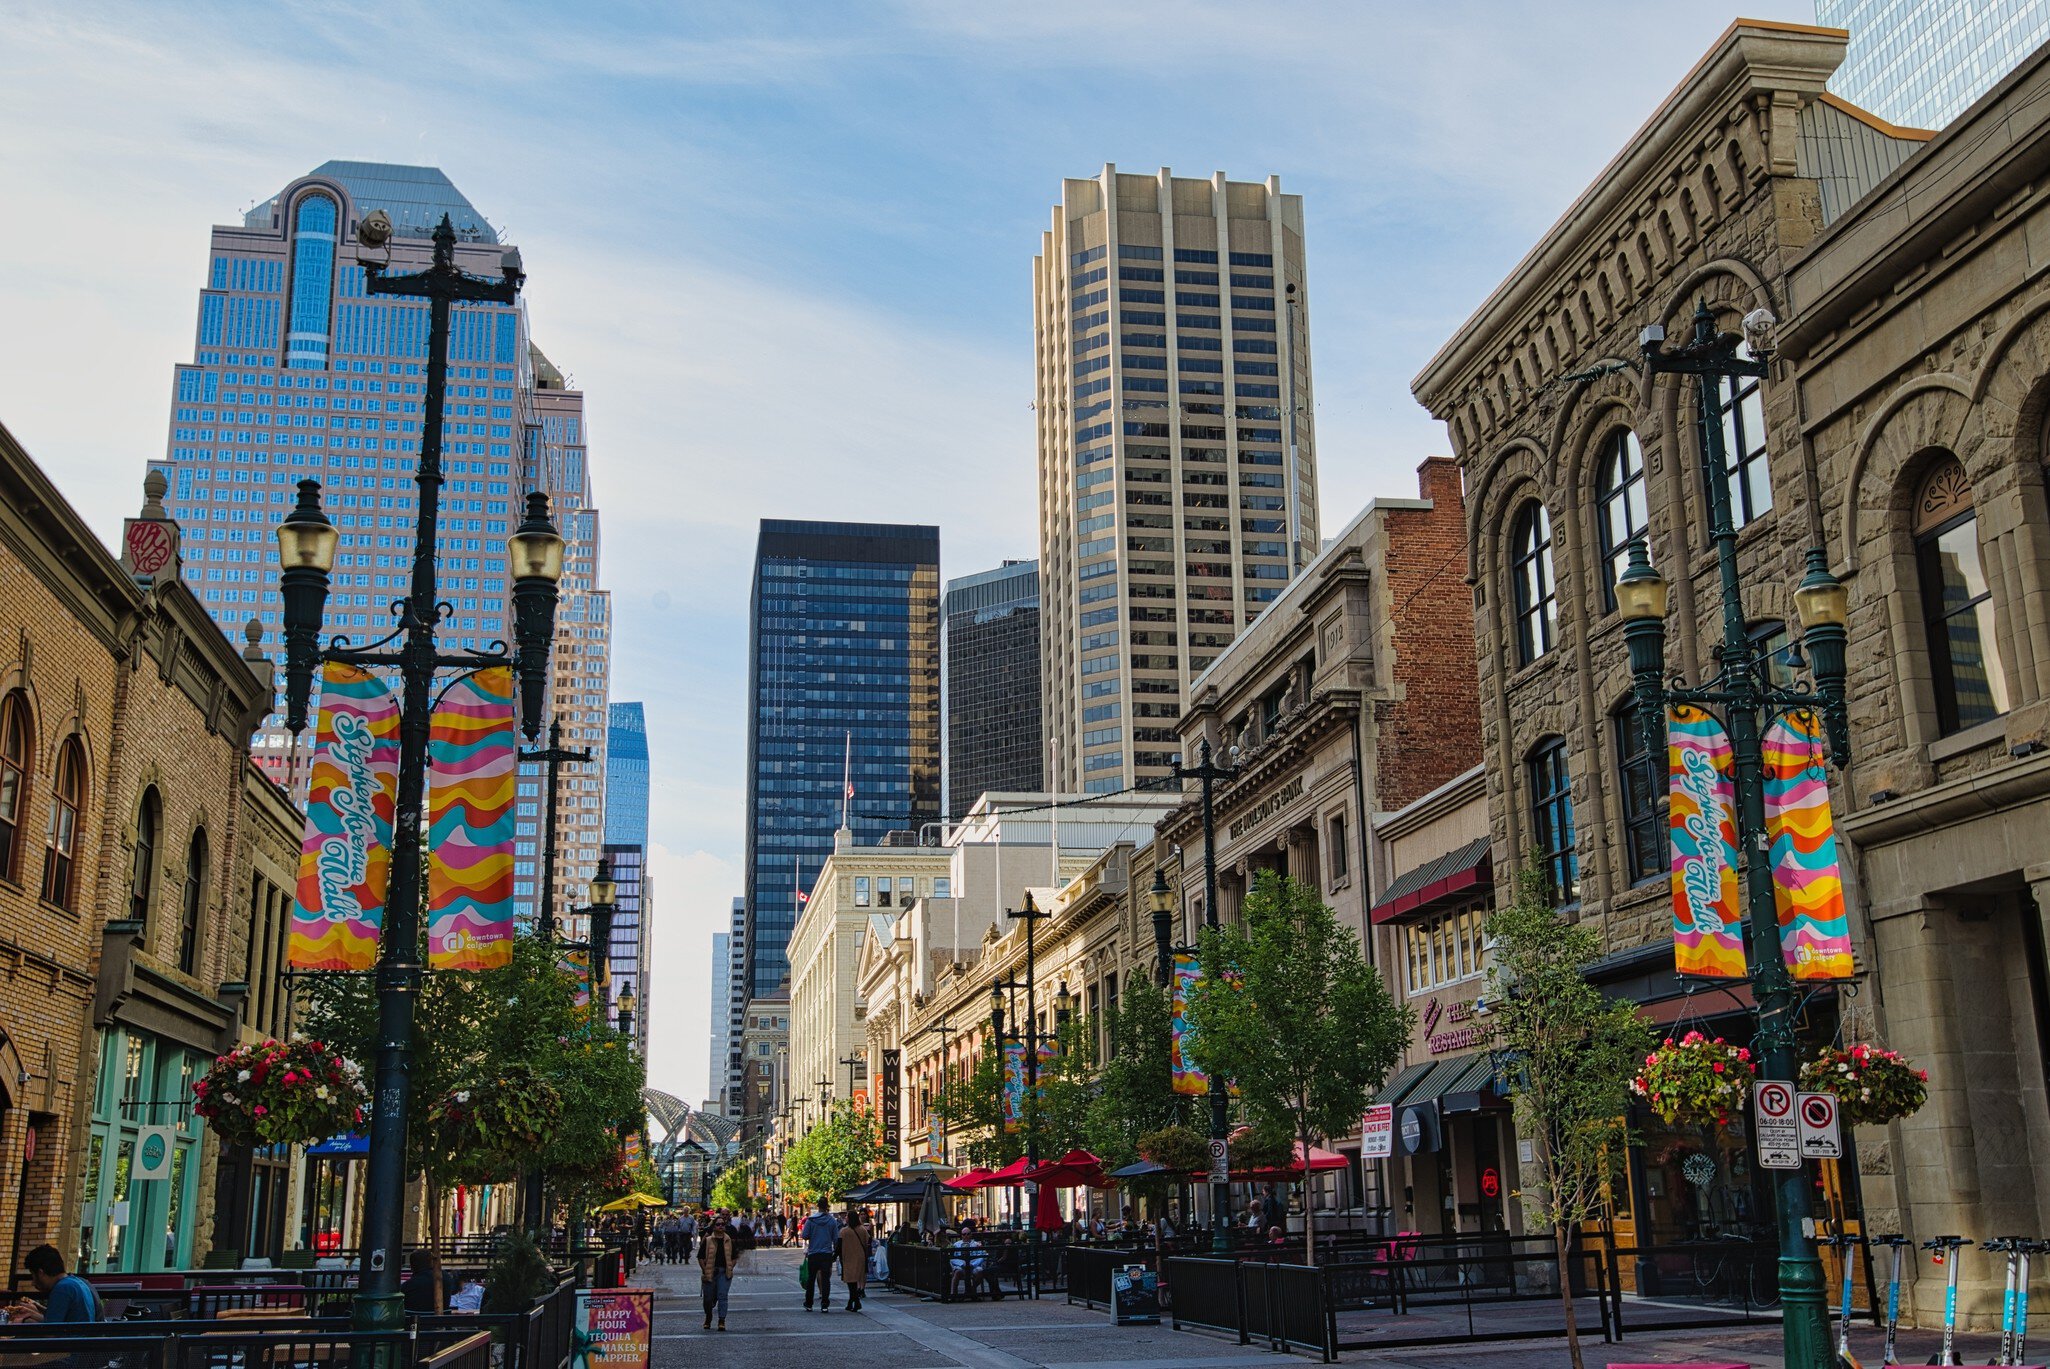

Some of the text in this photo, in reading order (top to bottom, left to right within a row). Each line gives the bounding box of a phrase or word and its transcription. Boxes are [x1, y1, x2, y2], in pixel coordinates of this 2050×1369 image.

[1327, 624, 1344, 651] 1912
[331, 714, 379, 882] Stephen Avenue
[1229, 818, 1243, 840] THE
[1280, 775, 1304, 806] BANK
[1683, 750, 1726, 901] Stephen Avenue
[321, 842, 359, 921] Walk
[1684, 861, 1724, 933] Walk
[466, 933, 504, 942] downtown
[466, 941, 494, 950] calgary
[1813, 954, 1835, 962] calgary
[884, 1056, 900, 1156] WINNERS
[598, 1310, 632, 1319] HAPPY
[597, 1320, 626, 1329] HOUR
[589, 1332, 631, 1342] TEQUILA
[600, 1343, 636, 1352] MAKES
[594, 1353, 642, 1363] HAPPIER.
